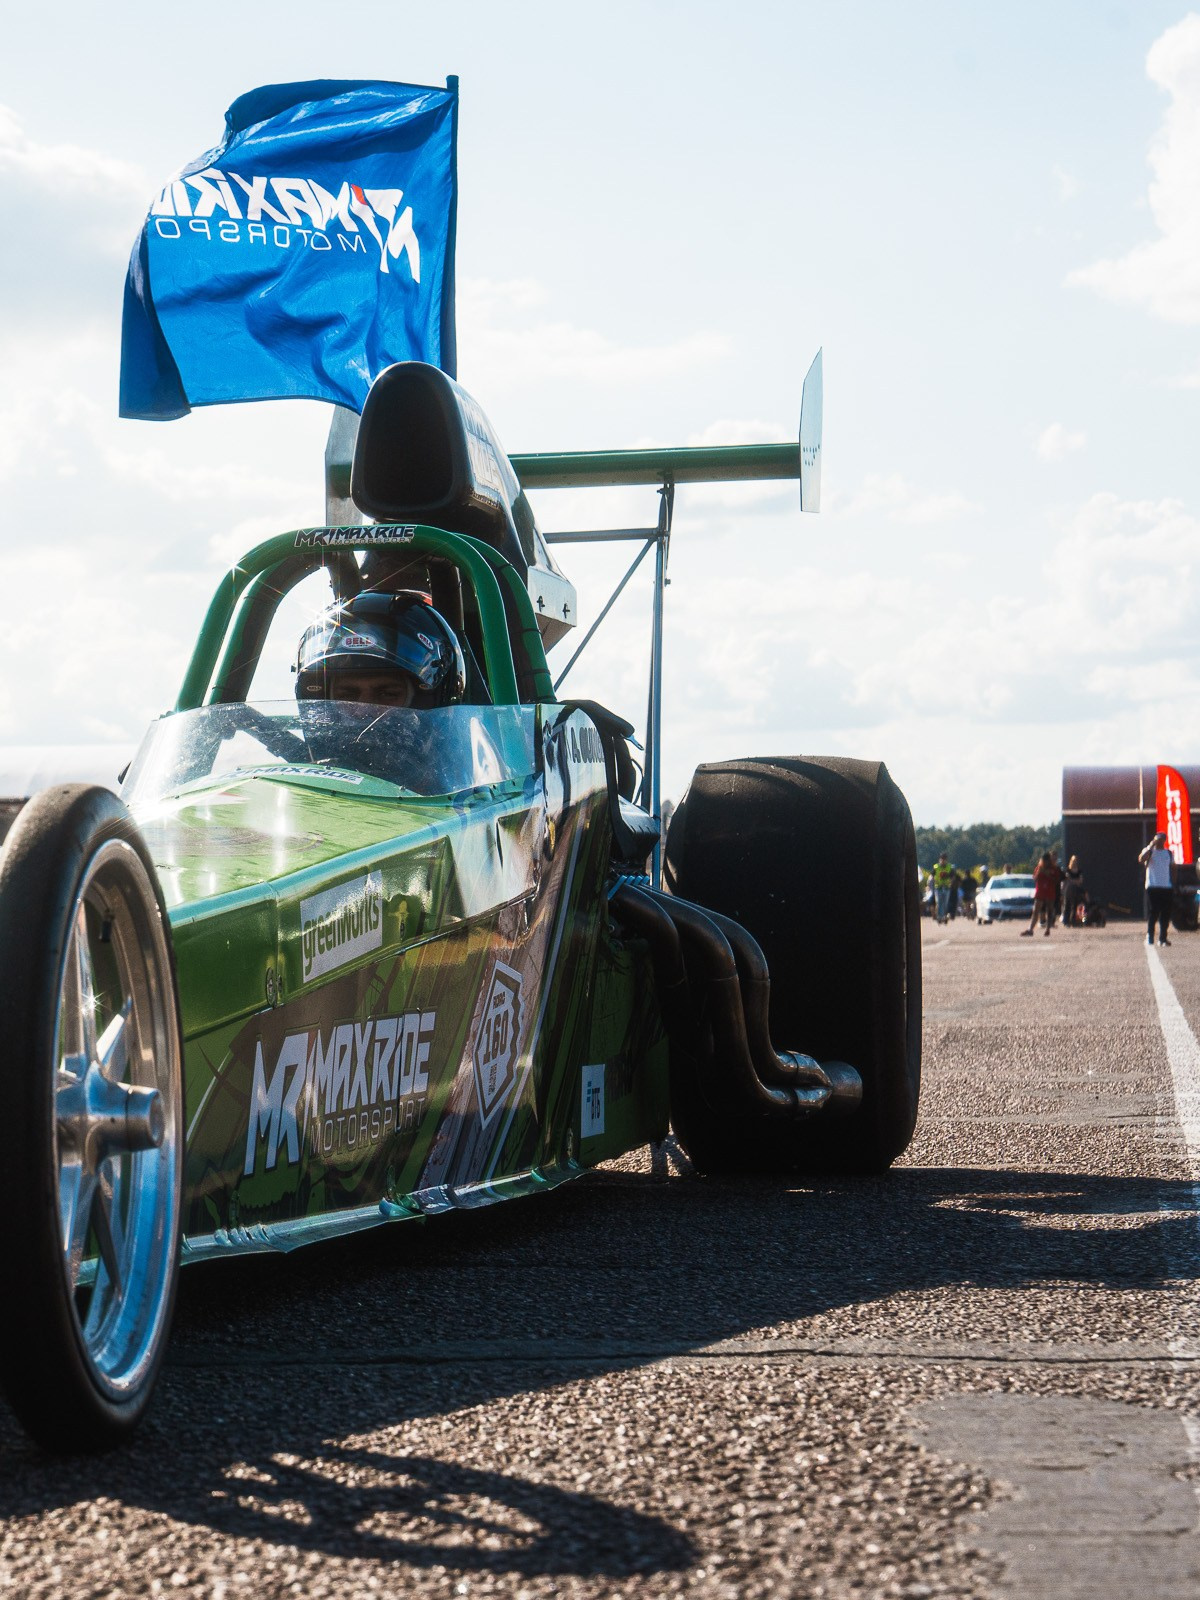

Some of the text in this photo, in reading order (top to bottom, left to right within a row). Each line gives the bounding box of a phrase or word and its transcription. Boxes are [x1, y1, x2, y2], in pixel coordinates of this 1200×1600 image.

[345, 636, 373, 646] BELL
[419, 634, 434, 648] BELL
[303, 892, 380, 976] greenworks
[483, 1009, 509, 1065] 160
[310, 1097, 426, 1154] MOTORSPORT
